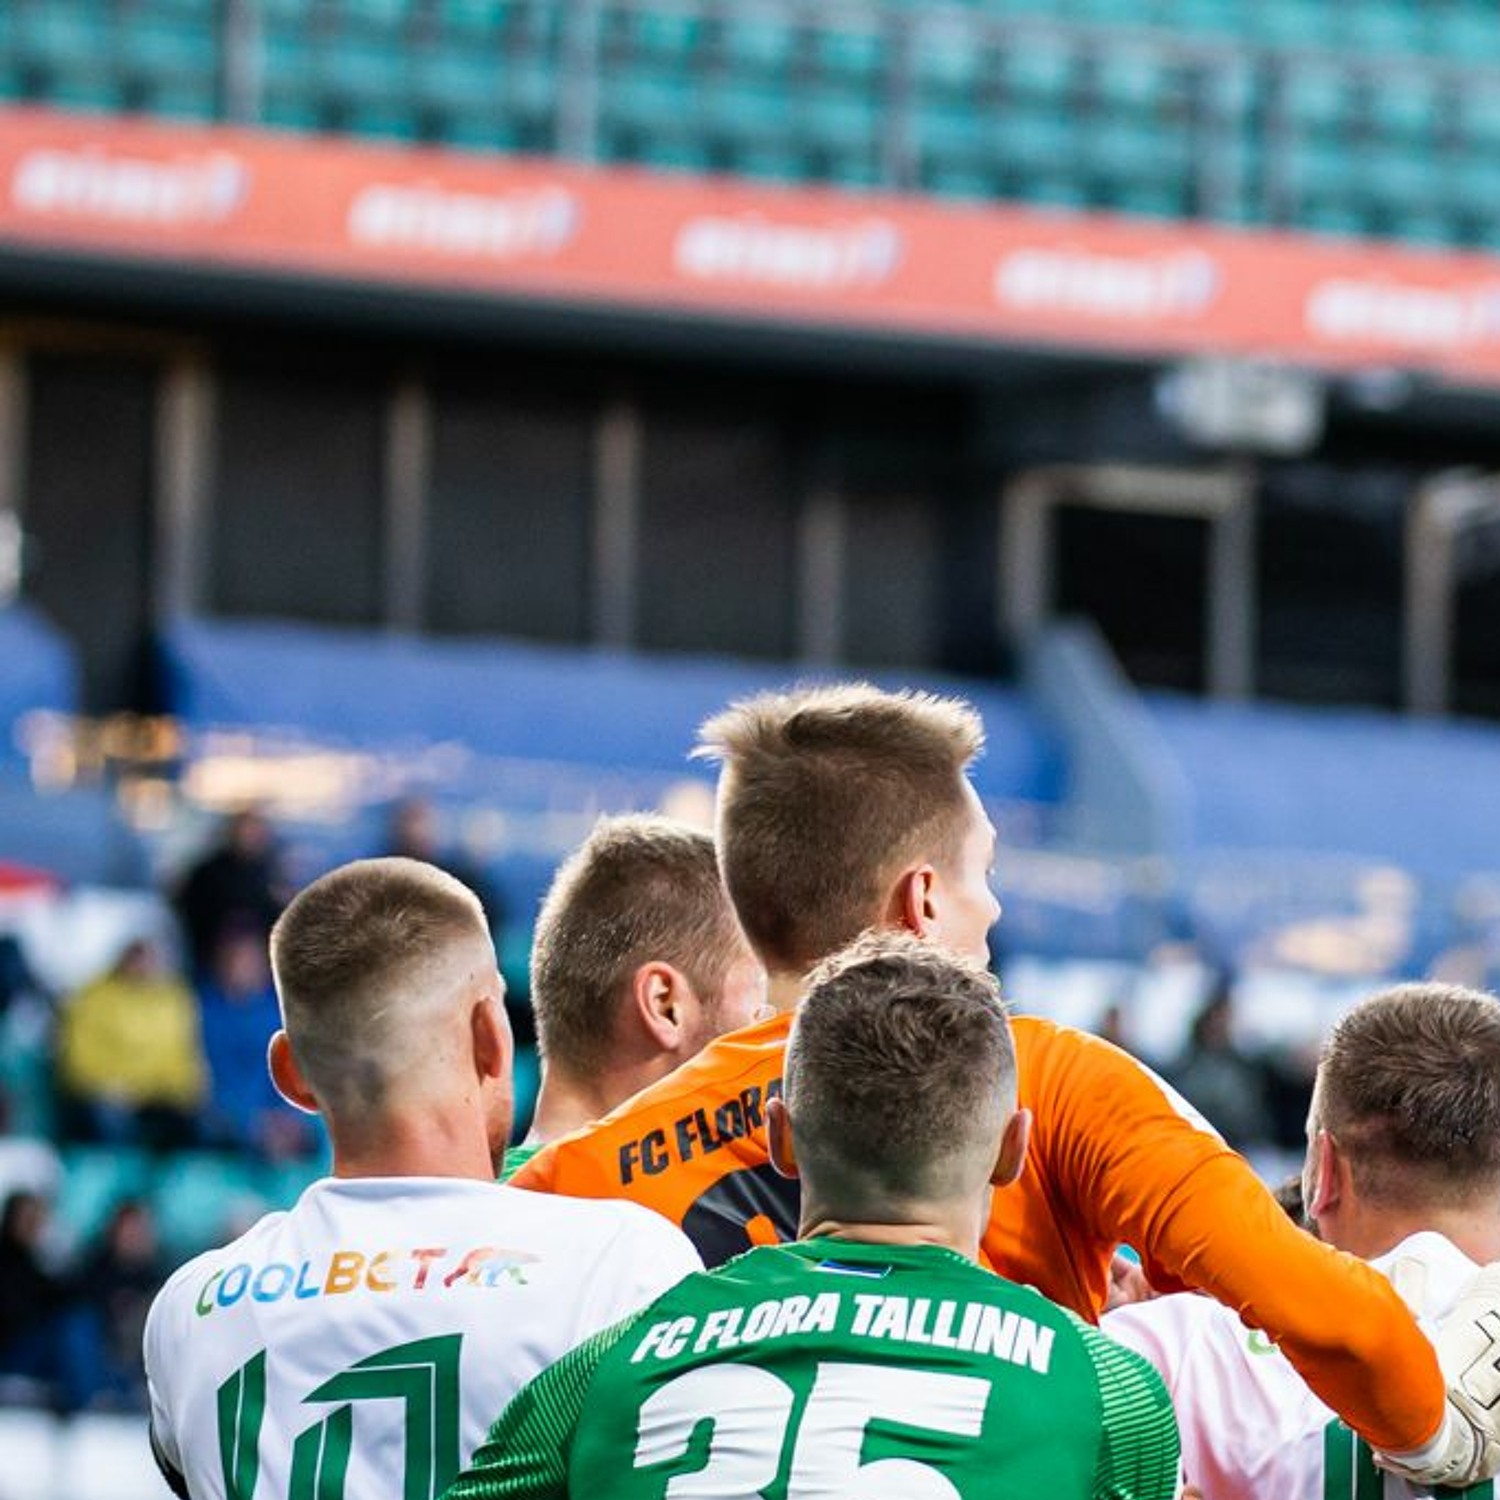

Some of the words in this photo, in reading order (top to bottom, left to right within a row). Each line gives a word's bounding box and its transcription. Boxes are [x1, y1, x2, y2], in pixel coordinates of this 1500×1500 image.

[619, 1129, 669, 1186] FC
[630, 1315, 696, 1364] FC
[692, 1292, 841, 1354] FLORA
[850, 1294, 1056, 1374] TALLINN
